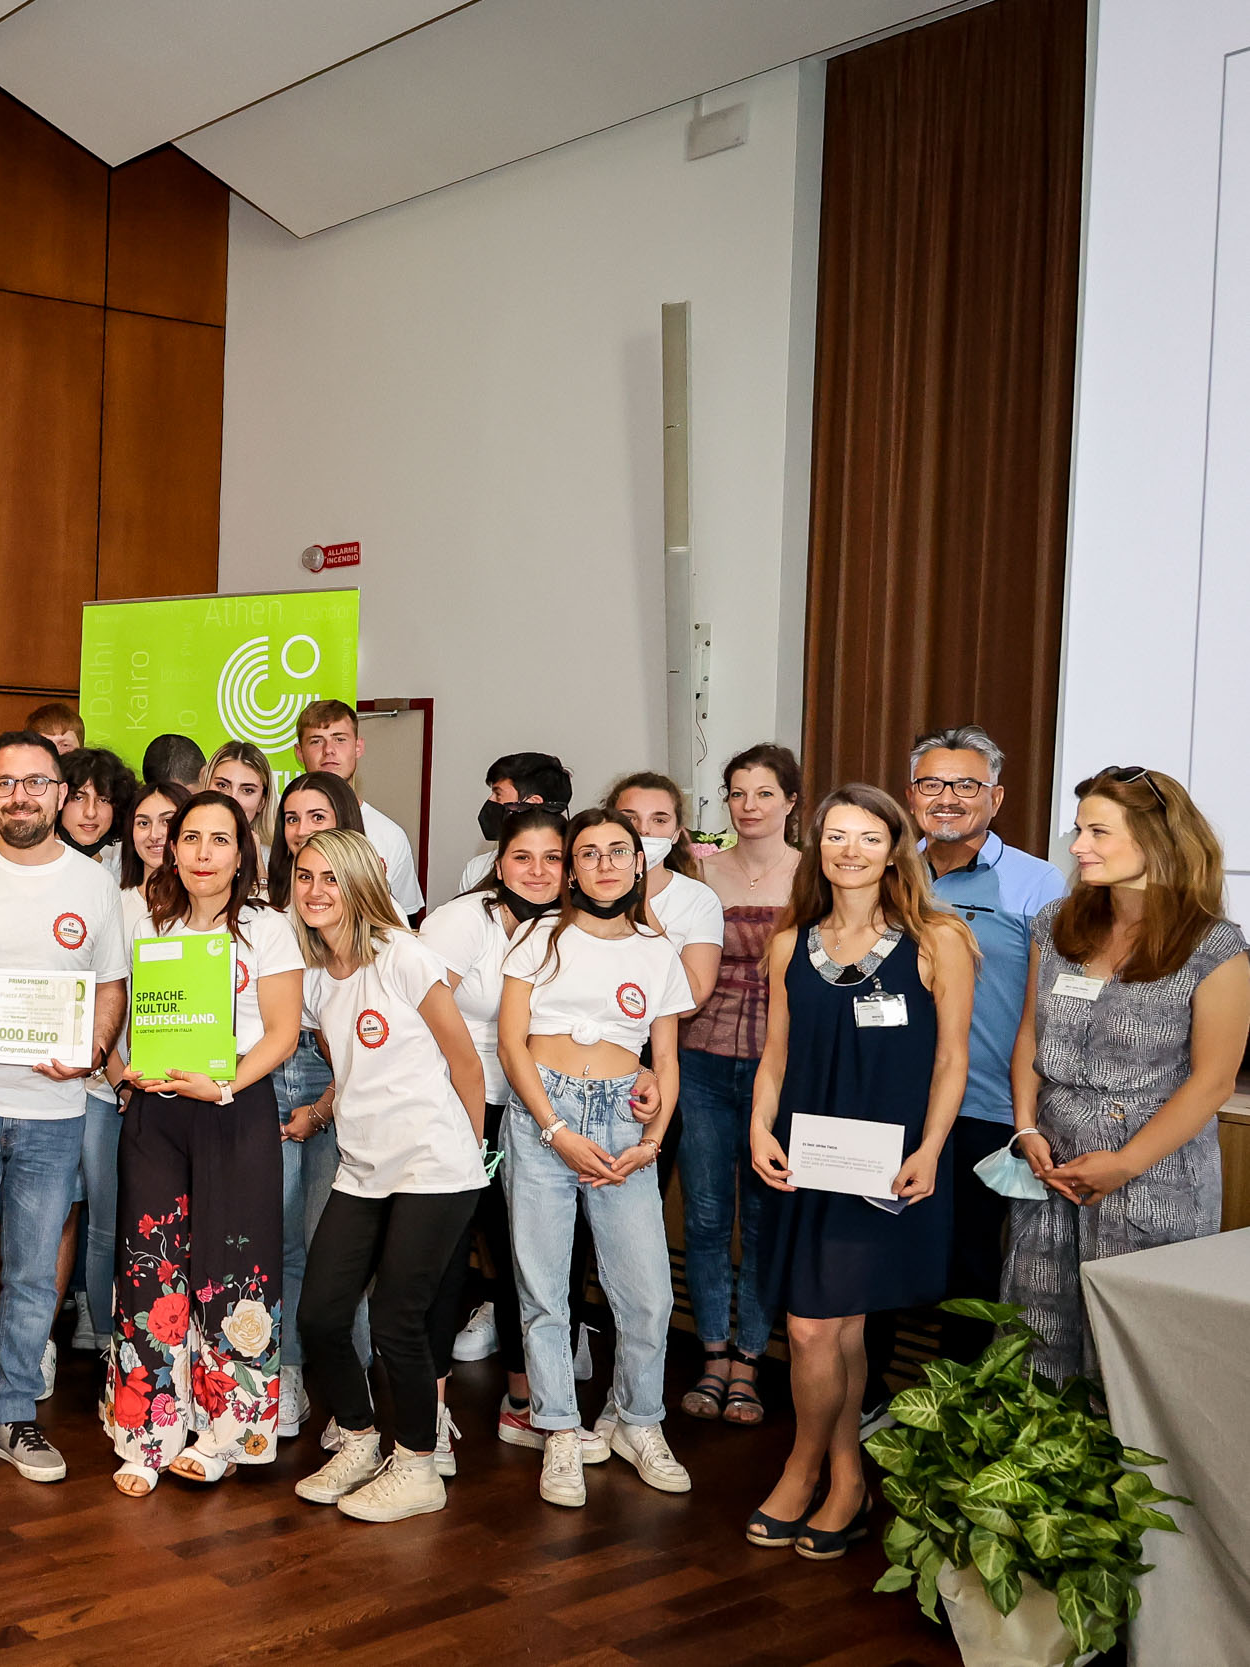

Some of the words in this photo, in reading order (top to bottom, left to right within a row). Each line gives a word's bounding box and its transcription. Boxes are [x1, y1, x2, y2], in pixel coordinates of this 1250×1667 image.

[327, 546, 358, 557] ALLARME
[326, 554, 359, 565] INCENDIO
[203, 598, 283, 627] Athen
[89, 641, 113, 716] Delhi
[126, 651, 150, 730] Kairo
[135, 990, 187, 1002] SPRACHE.
[135, 1003, 180, 1014] KULTUR.
[135, 1013, 218, 1026] DEUTSCHLAND.
[27, 1029, 58, 1042] Euro
